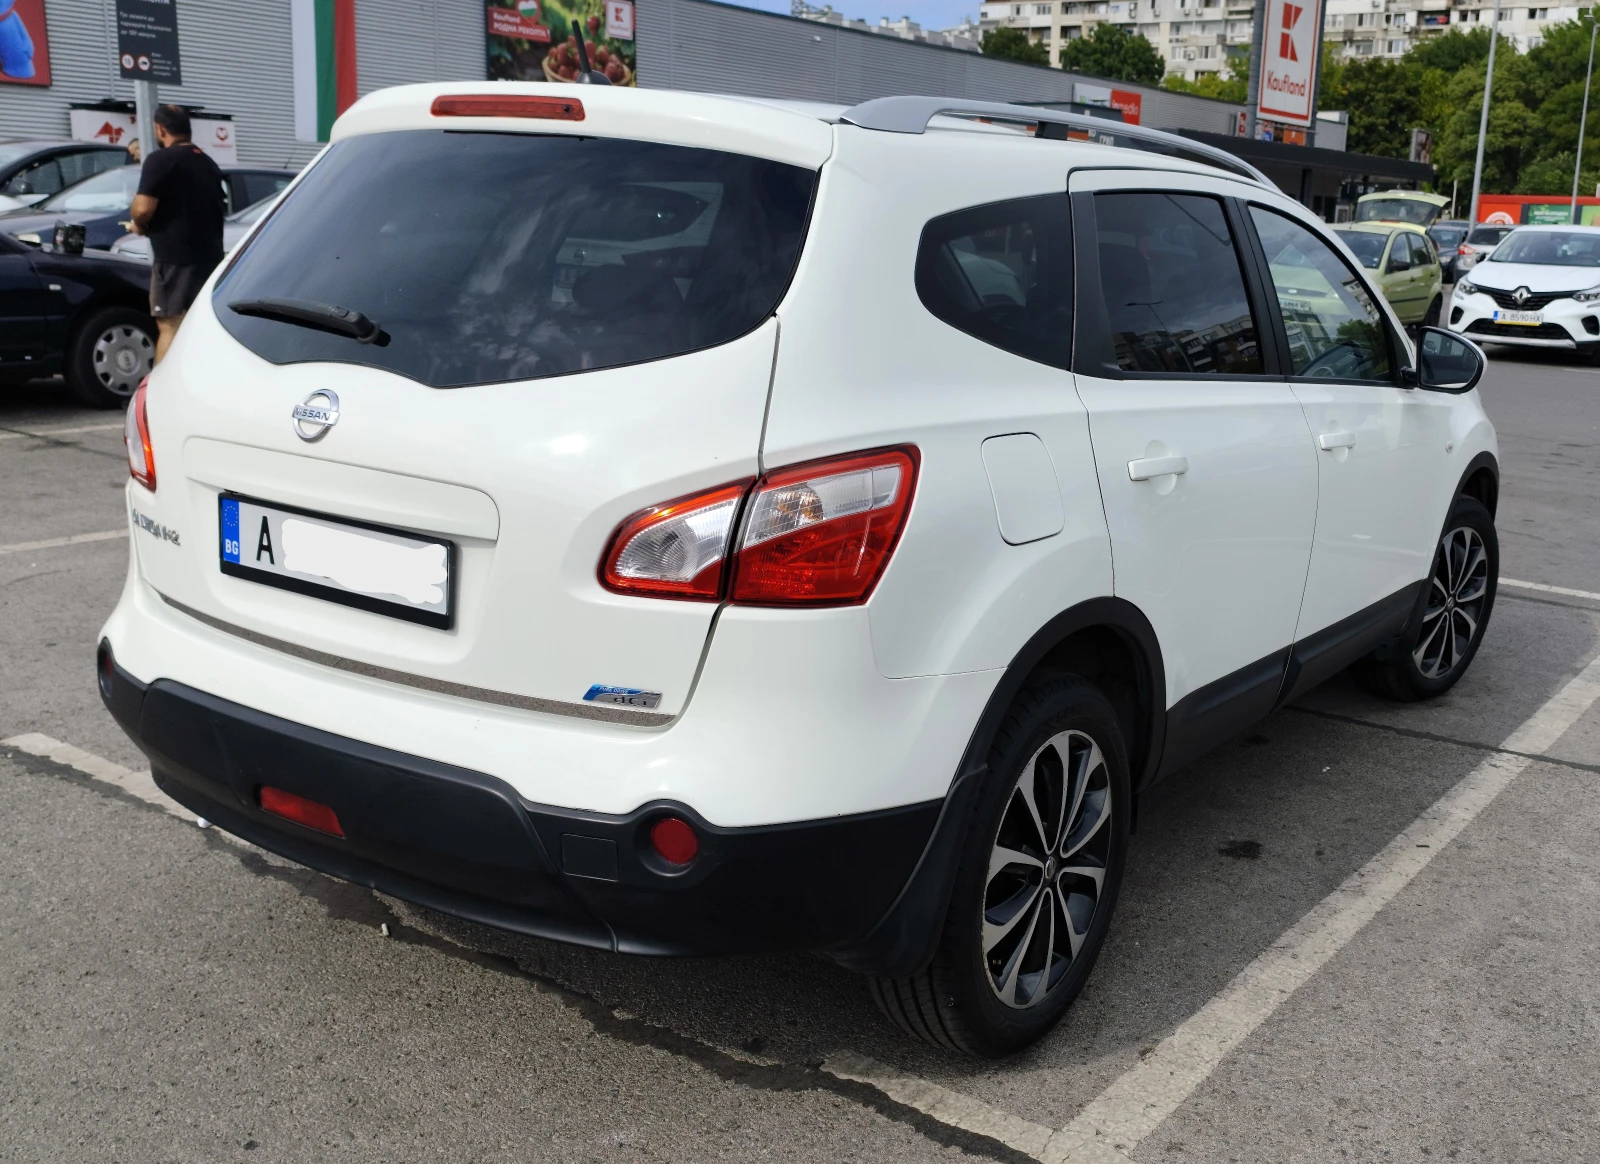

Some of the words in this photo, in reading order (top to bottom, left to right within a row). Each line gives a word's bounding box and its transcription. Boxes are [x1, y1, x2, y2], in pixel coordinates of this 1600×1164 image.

[1266, 70, 1307, 97] Kaufland
[1510, 313, 1530, 322] 8590
[294, 406, 331, 422] NISSAN
[225, 538, 239, 556] BG
[256, 515, 275, 565] A
